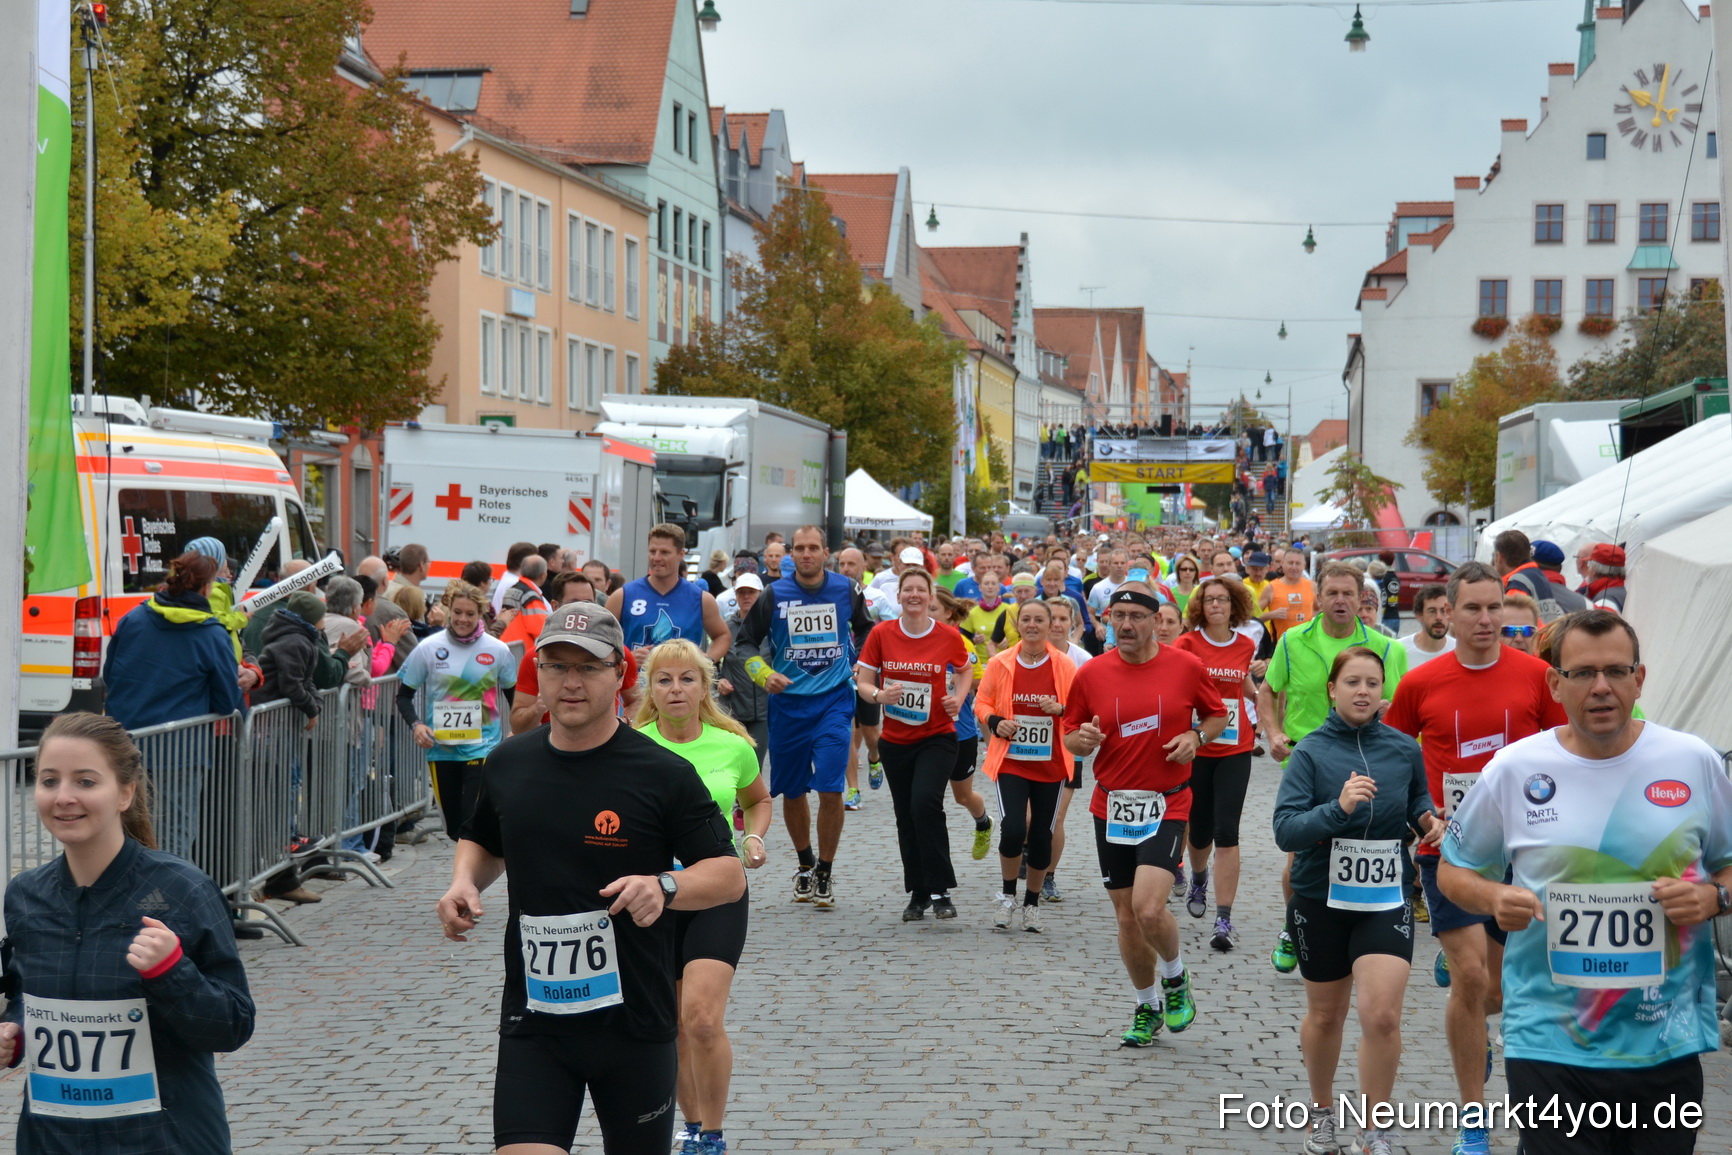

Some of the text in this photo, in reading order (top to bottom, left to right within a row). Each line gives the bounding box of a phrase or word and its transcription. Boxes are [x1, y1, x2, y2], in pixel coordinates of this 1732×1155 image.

[1135, 467, 1186, 480] START
[479, 484, 549, 498] Bayerisches
[479, 499, 512, 511] Rotes
[141, 516, 177, 536] Bayerisches
[478, 513, 512, 525] Kreuz
[850, 516, 895, 528] Laufsport
[143, 535, 162, 554] Rotes
[145, 555, 163, 573] Kreuz
[252, 561, 335, 609] bmw-laufsport.de
[630, 599, 648, 616] 8
[564, 614, 590, 631] 85
[793, 614, 833, 633] 2019
[804, 635, 824, 643] Simon
[883, 661, 933, 672] NEUMARKT
[1207, 667, 1242, 679] MARKT
[442, 712, 473, 728] 274
[1131, 721, 1148, 732] DEHN
[1015, 746, 1039, 755] Sandra
[1472, 740, 1492, 751] DEHN
[1651, 786, 1686, 800] Hervis
[1112, 800, 1161, 823] 2574
[1526, 807, 1558, 820] PARTL
[1526, 816, 1558, 827] Neumarkt
[1333, 842, 1393, 855] PARTL Neumarkt
[1337, 856, 1397, 884] 3034
[1549, 891, 1644, 905] PARTL Neumarkt
[136, 900, 170, 911] adidas
[543, 922, 594, 935] Neumarkt
[1558, 908, 1655, 947] 2708
[527, 934, 607, 976] 2776
[1582, 957, 1629, 974] Dieter
[543, 983, 591, 1000] Roland
[26, 1006, 123, 1024] PARTL Neumarkt
[34, 1025, 137, 1073] 2077
[61, 1083, 115, 1102] Hanna
